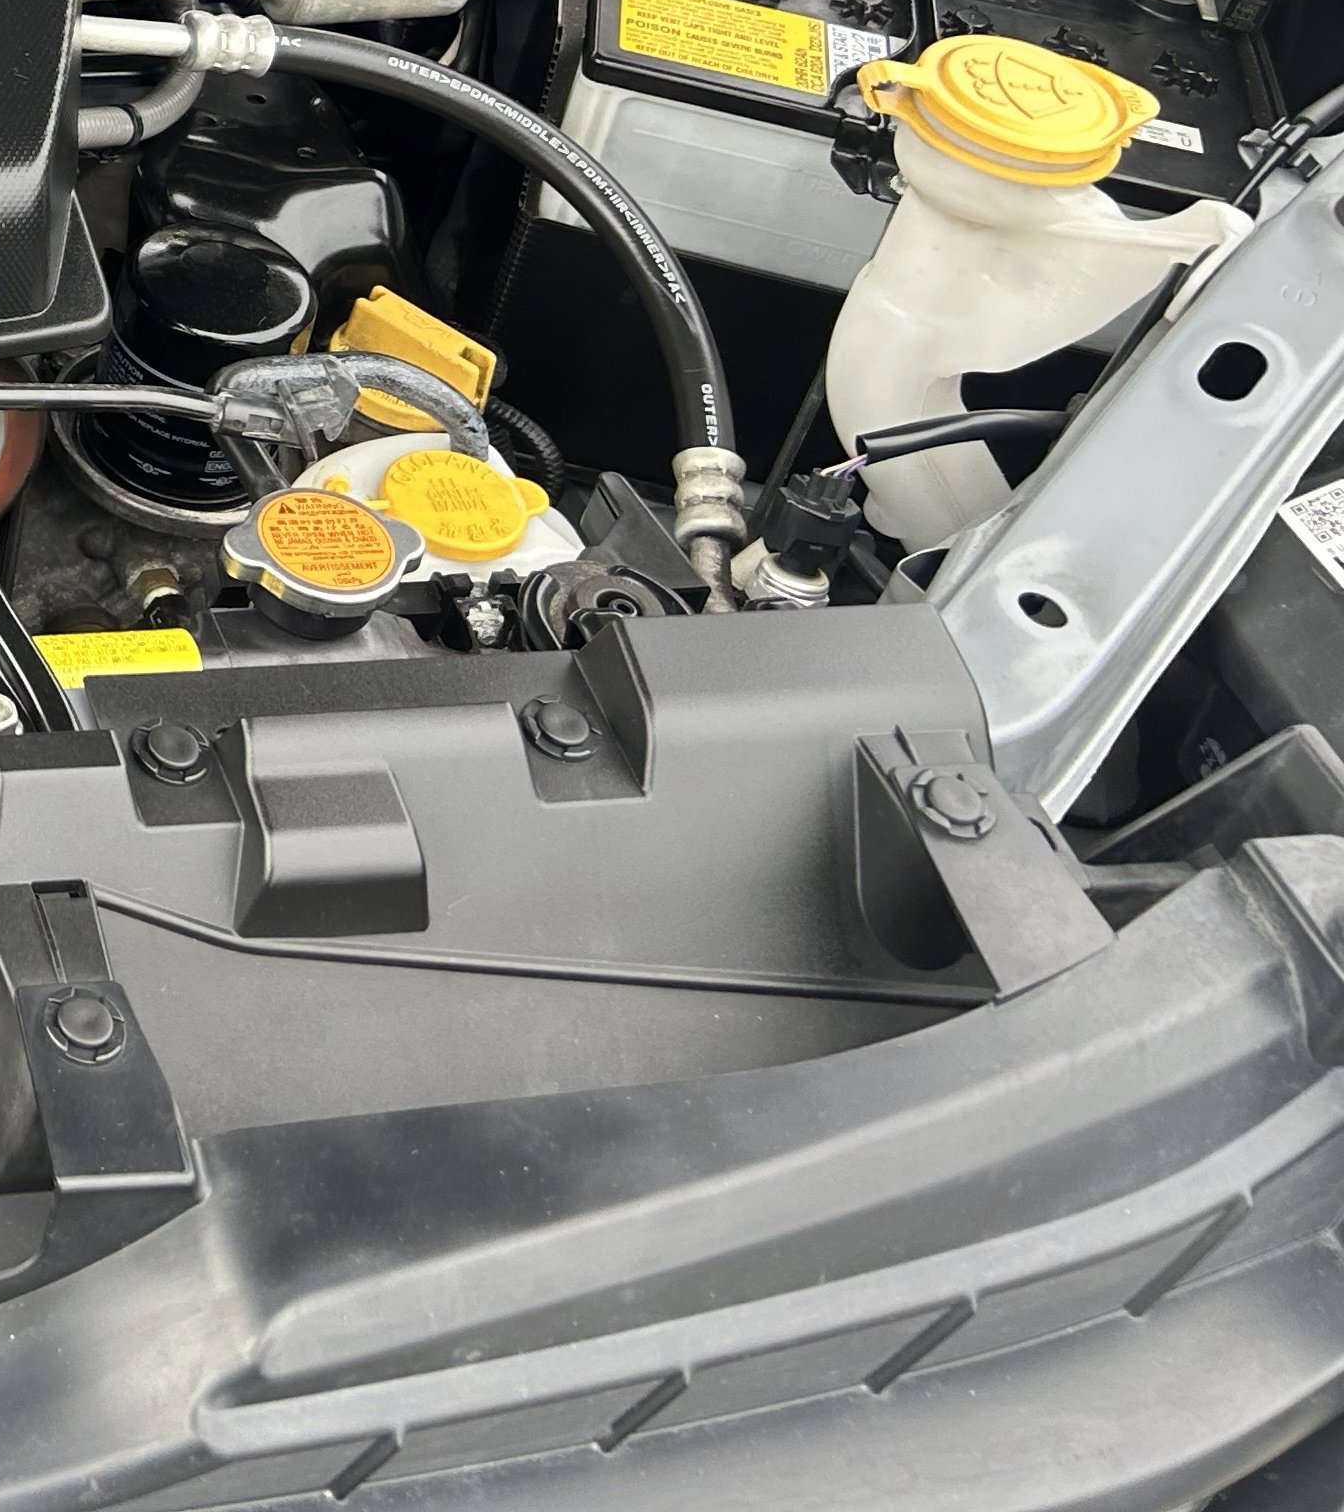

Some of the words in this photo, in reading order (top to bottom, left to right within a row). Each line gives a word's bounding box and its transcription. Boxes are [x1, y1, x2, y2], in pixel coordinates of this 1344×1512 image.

[626, 18, 681, 36] POISON
[686, 32, 718, 45] CAUSES
[113, 346, 144, 381] CAUTION
